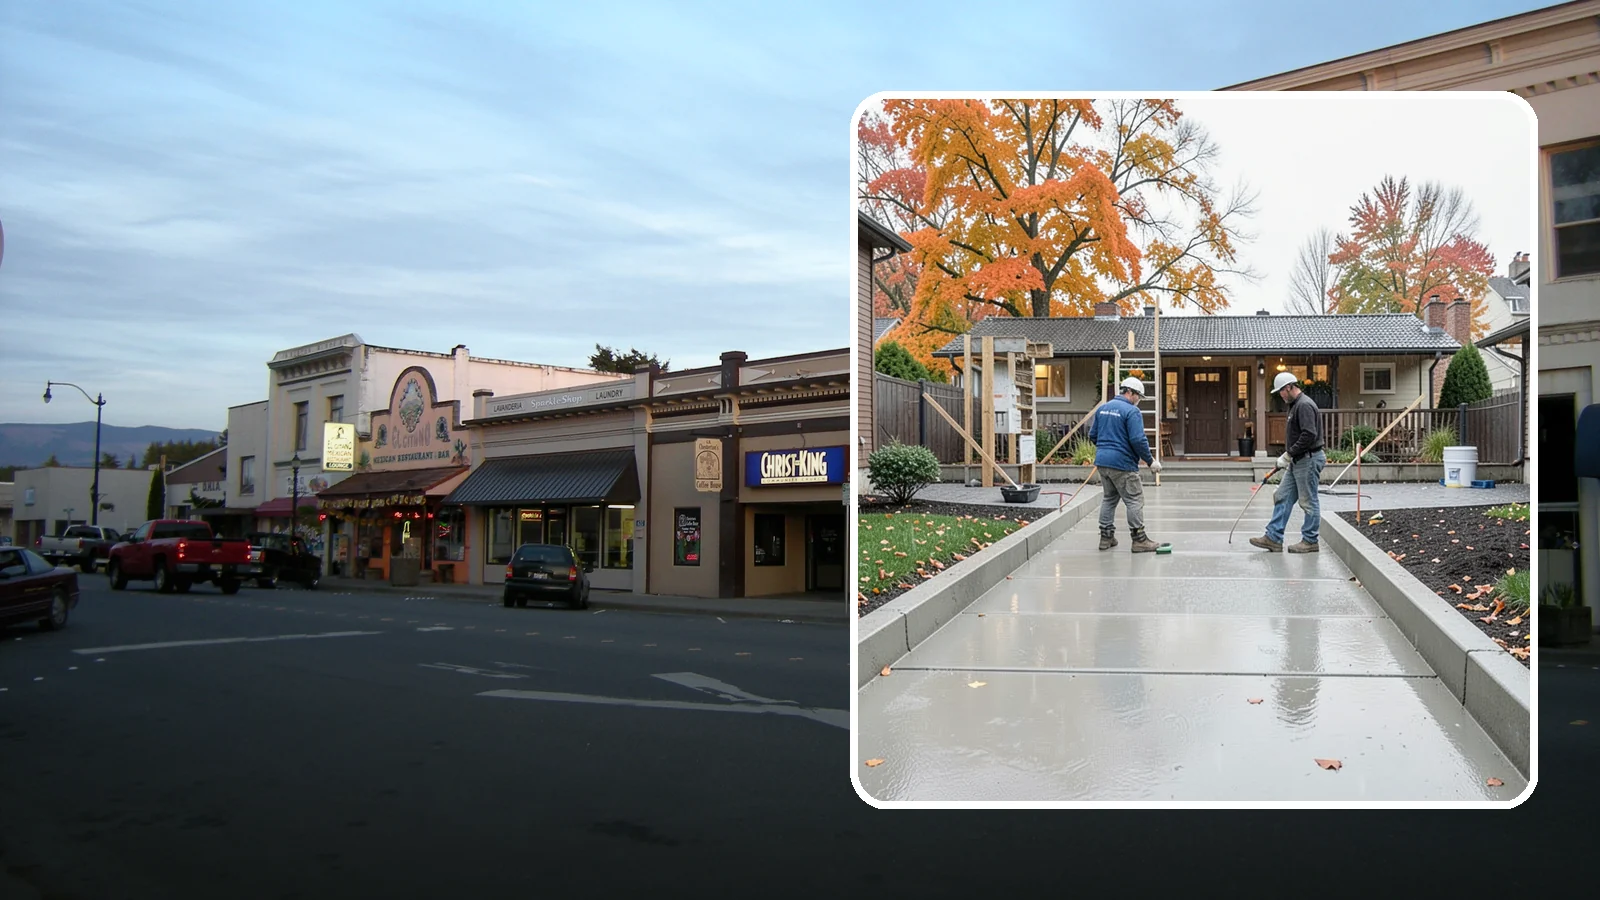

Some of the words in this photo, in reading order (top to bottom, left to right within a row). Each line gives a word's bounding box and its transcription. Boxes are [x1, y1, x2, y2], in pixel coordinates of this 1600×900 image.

[493, 402, 522, 412] LAVANDERIA
[531, 397, 560, 409] Sparkle
[561, 394, 582, 405] Shop
[595, 389, 623, 400] LAUNDRY
[373, 454, 396, 464] MEXICAN
[397, 451, 433, 462] RESTAURANT
[437, 450, 450, 459] BAR
[761, 452, 797, 478] CHRIST
[799, 450, 827, 476] KING
[697, 480, 709, 489] Coffee
